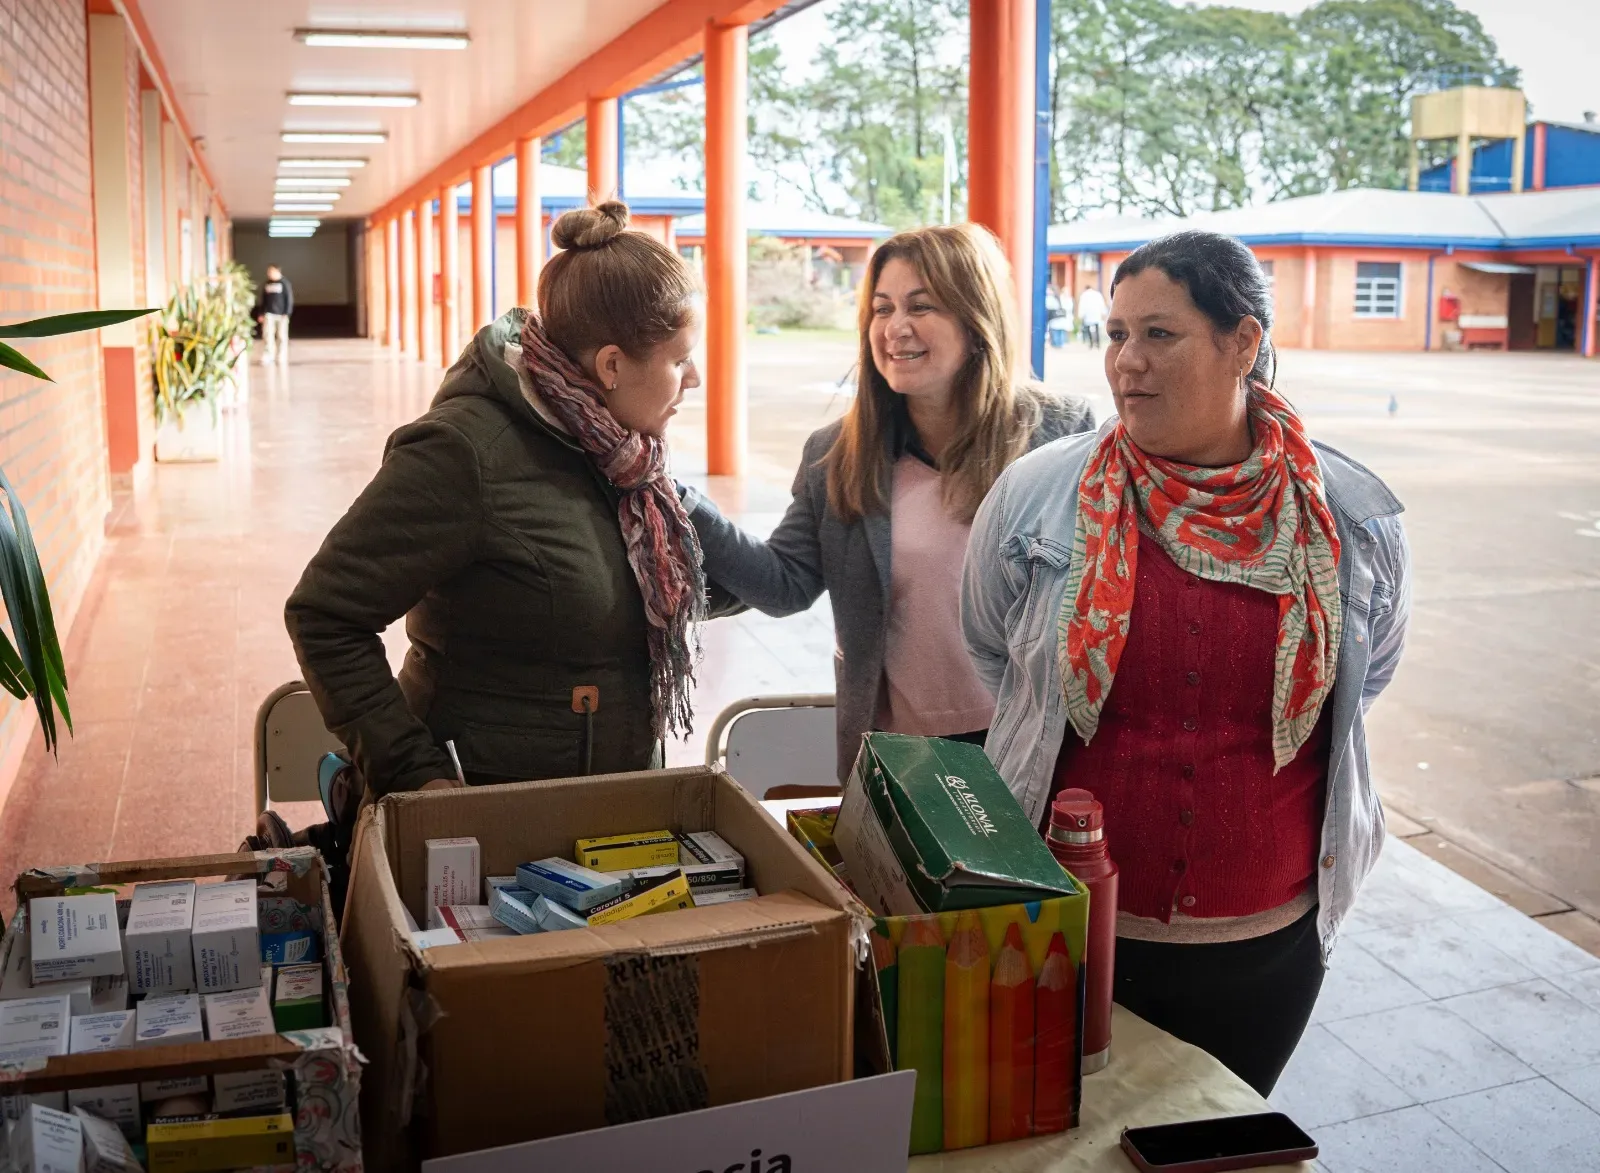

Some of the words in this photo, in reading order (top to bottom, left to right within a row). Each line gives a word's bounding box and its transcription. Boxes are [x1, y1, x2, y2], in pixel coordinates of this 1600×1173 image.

[962, 792, 998, 834] KLONAL
[590, 898, 622, 915] Coroval
[624, 893, 632, 901] 5
[591, 902, 634, 922] Amlodipina
[135, 949, 144, 988] AMOXICILINA
[201, 948, 211, 987] AMOXICILINA
